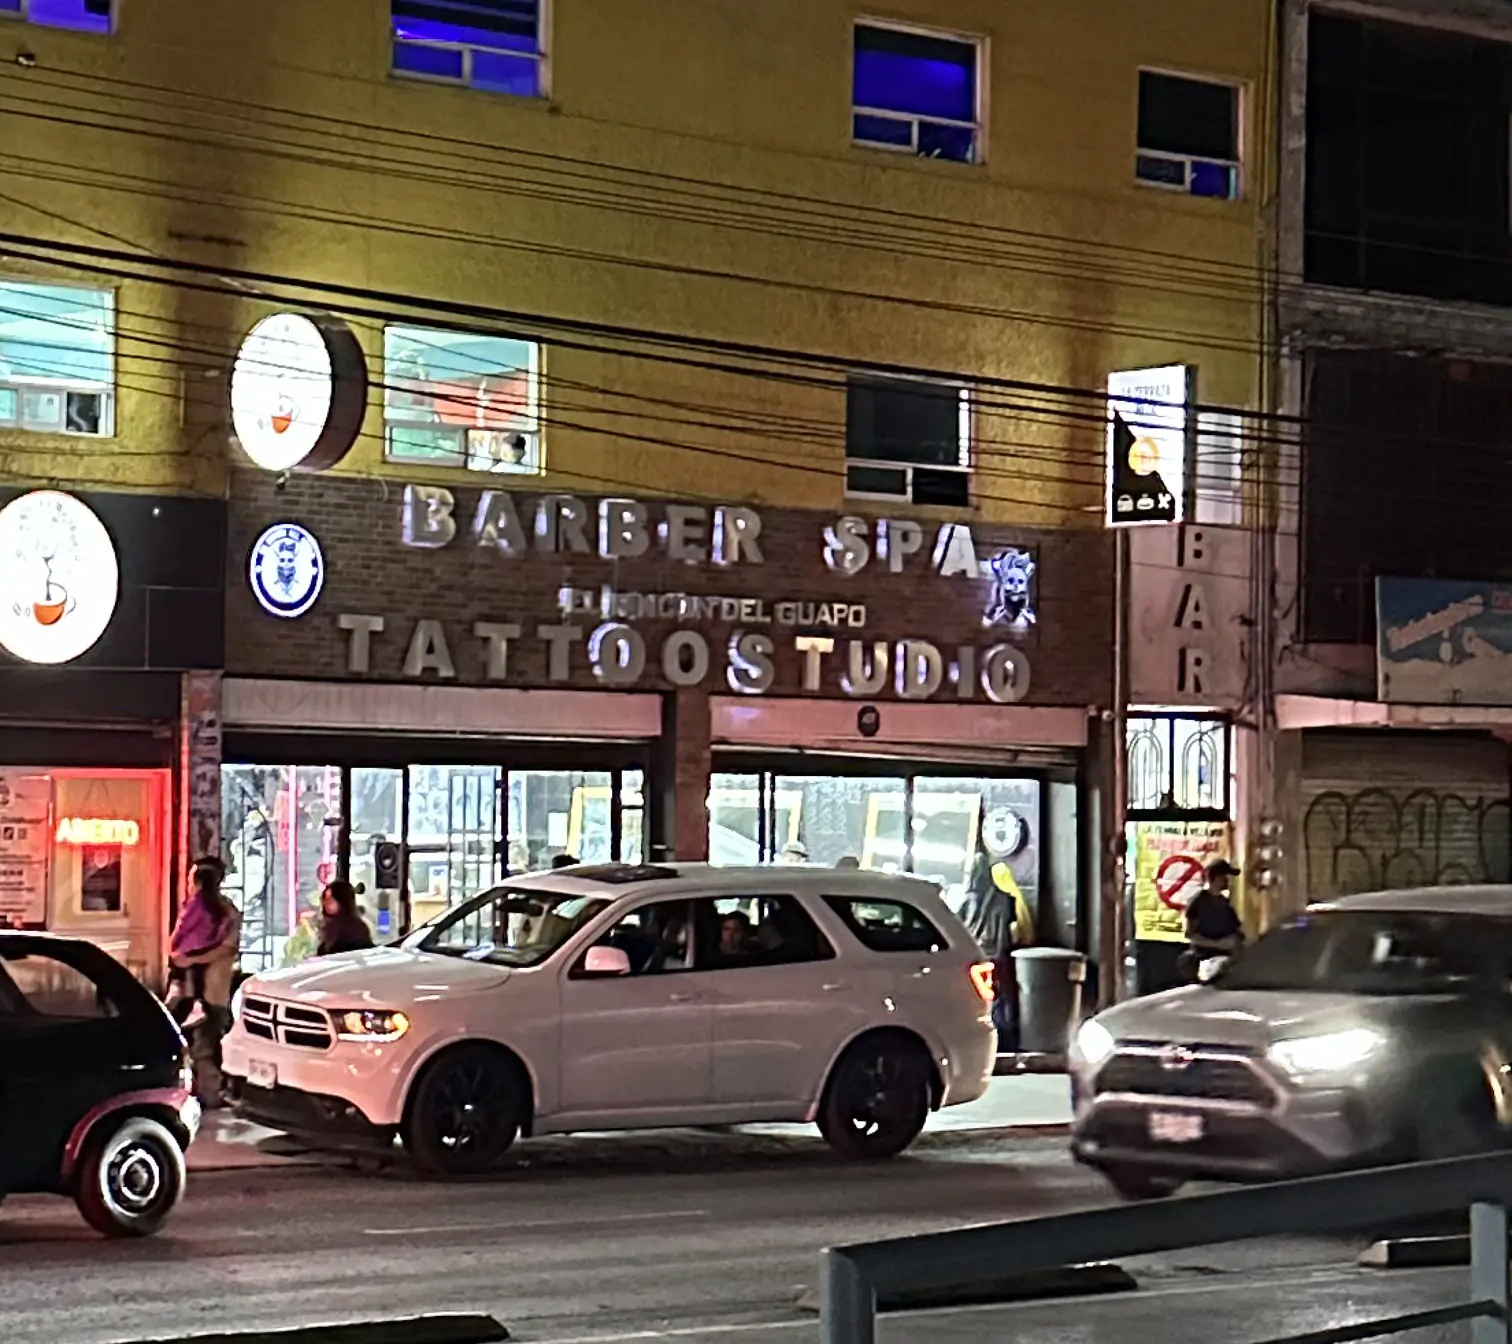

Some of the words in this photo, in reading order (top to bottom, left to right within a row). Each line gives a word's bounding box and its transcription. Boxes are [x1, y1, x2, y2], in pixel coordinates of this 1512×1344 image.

[402, 484, 765, 565] BARBER
[822, 515, 980, 579] SPA
[721, 598, 772, 623] DEL
[775, 602, 867, 628] GUAPO
[1174, 524, 1212, 696] BAR
